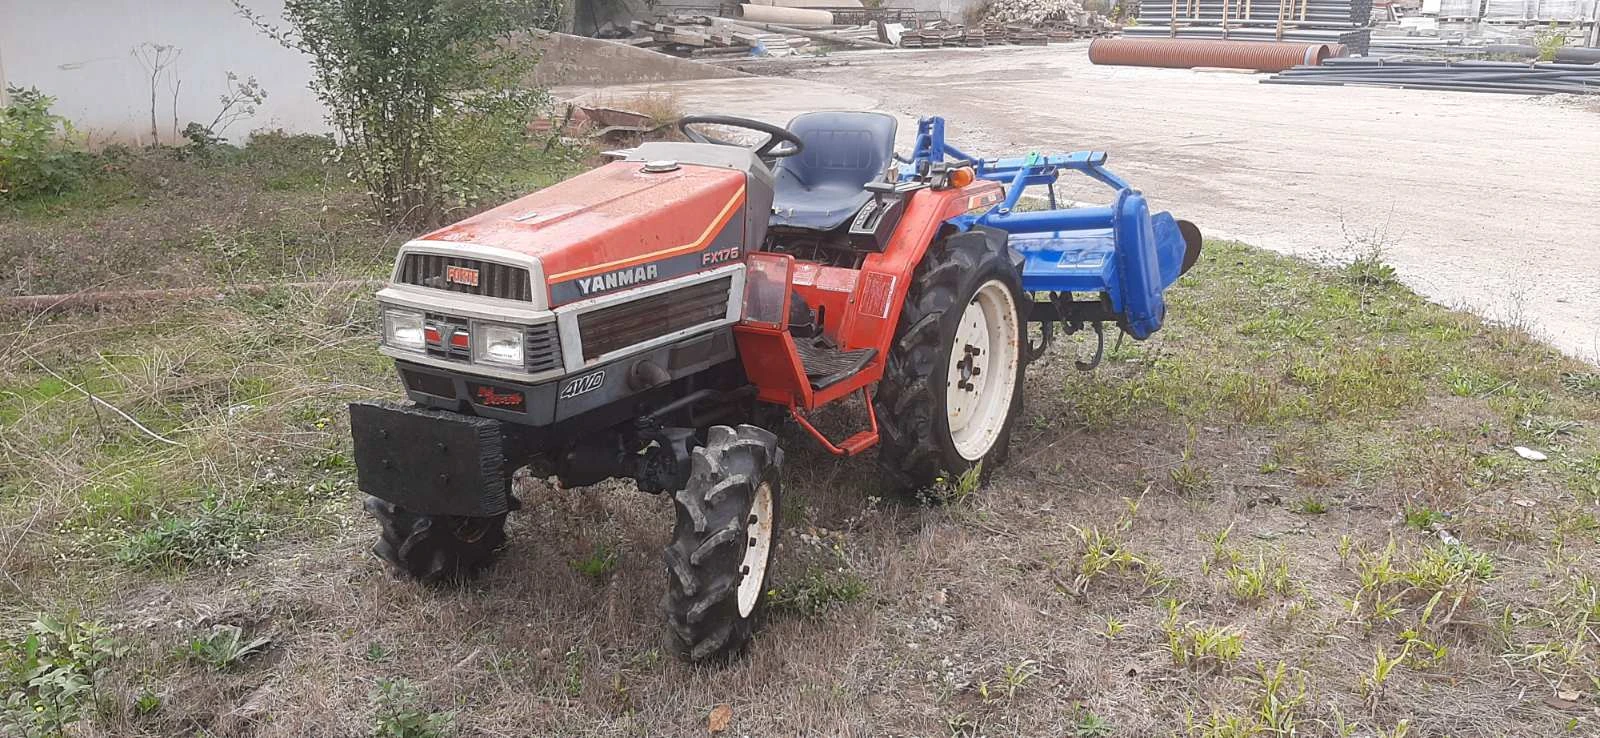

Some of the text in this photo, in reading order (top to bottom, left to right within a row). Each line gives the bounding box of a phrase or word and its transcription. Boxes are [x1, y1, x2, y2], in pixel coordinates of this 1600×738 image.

[447, 265, 479, 286] FORTE
[579, 264, 658, 295] YANMAR
[560, 371, 605, 399] 4WD
